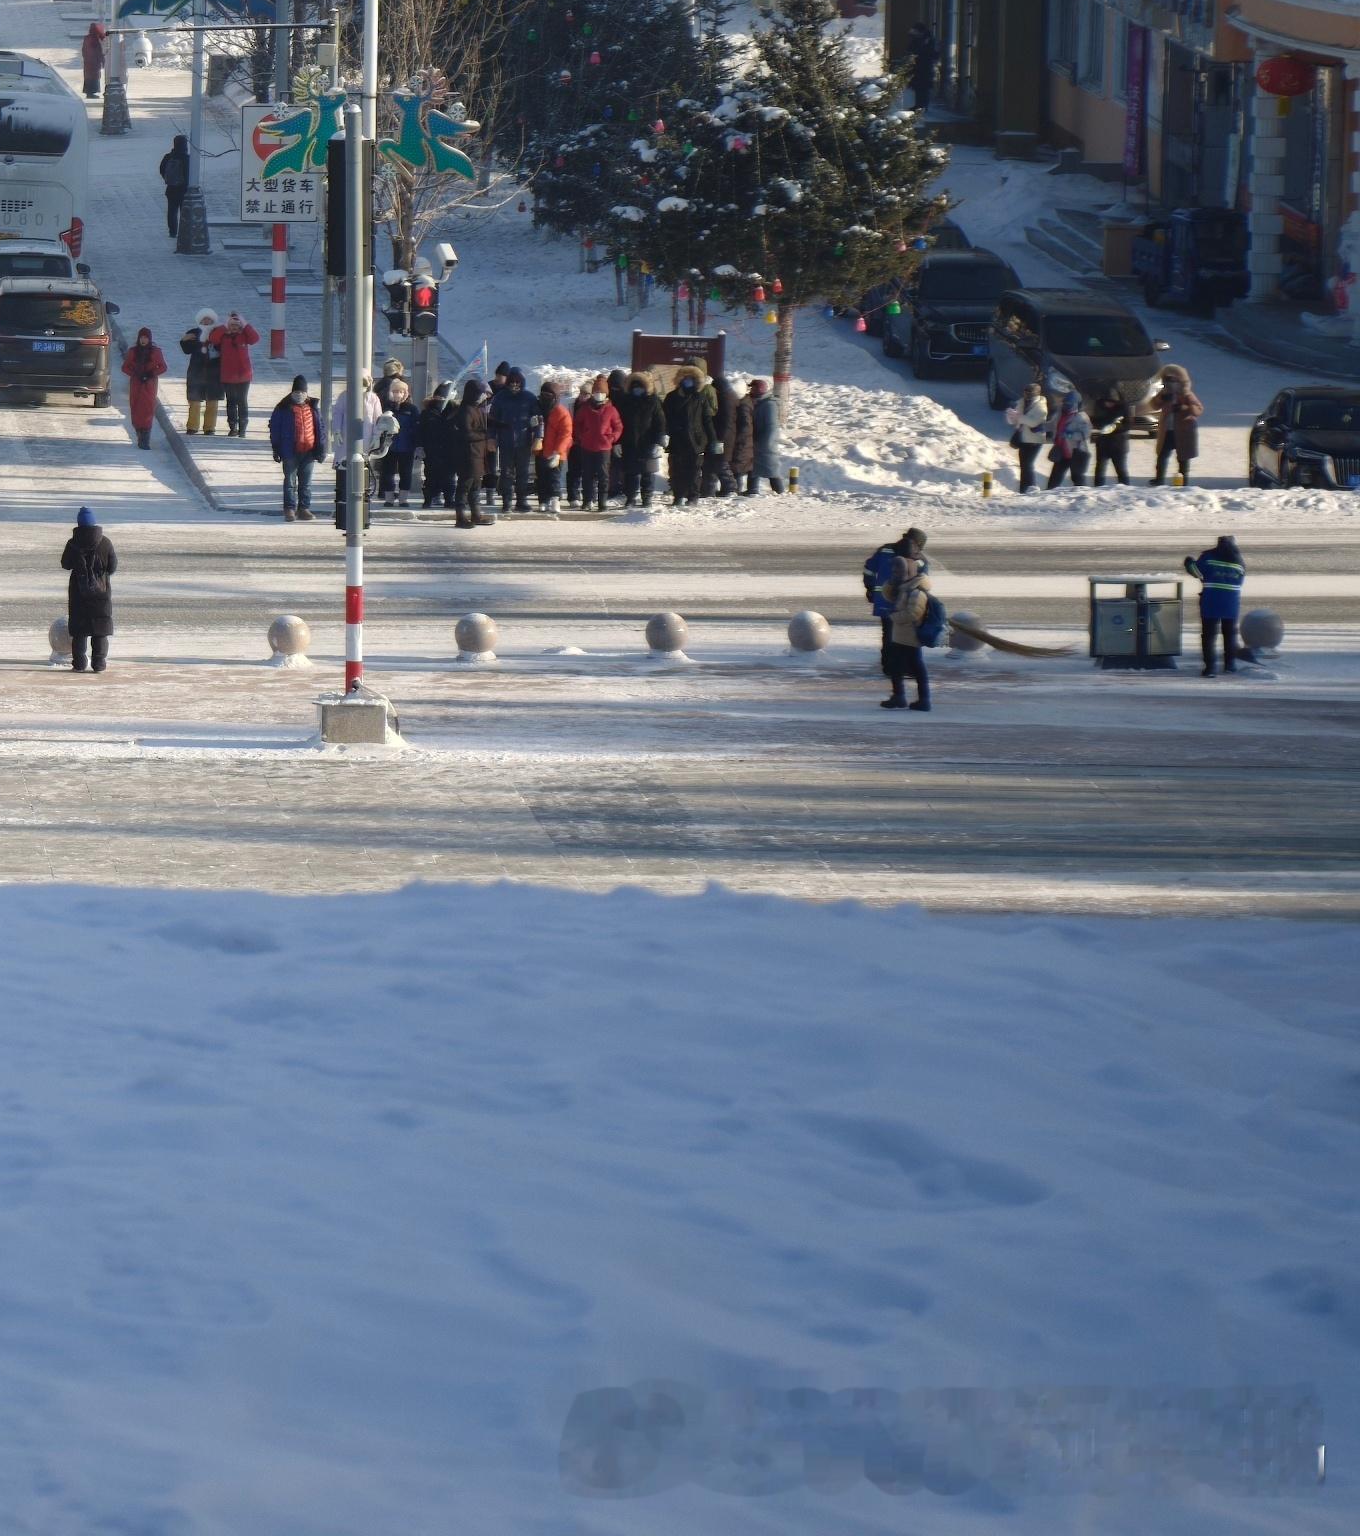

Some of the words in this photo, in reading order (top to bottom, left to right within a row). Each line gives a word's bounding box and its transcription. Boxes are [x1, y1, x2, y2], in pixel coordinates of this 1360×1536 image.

[246, 177, 314, 194] 大型货车
[245, 199, 315, 215] 禁止通行
